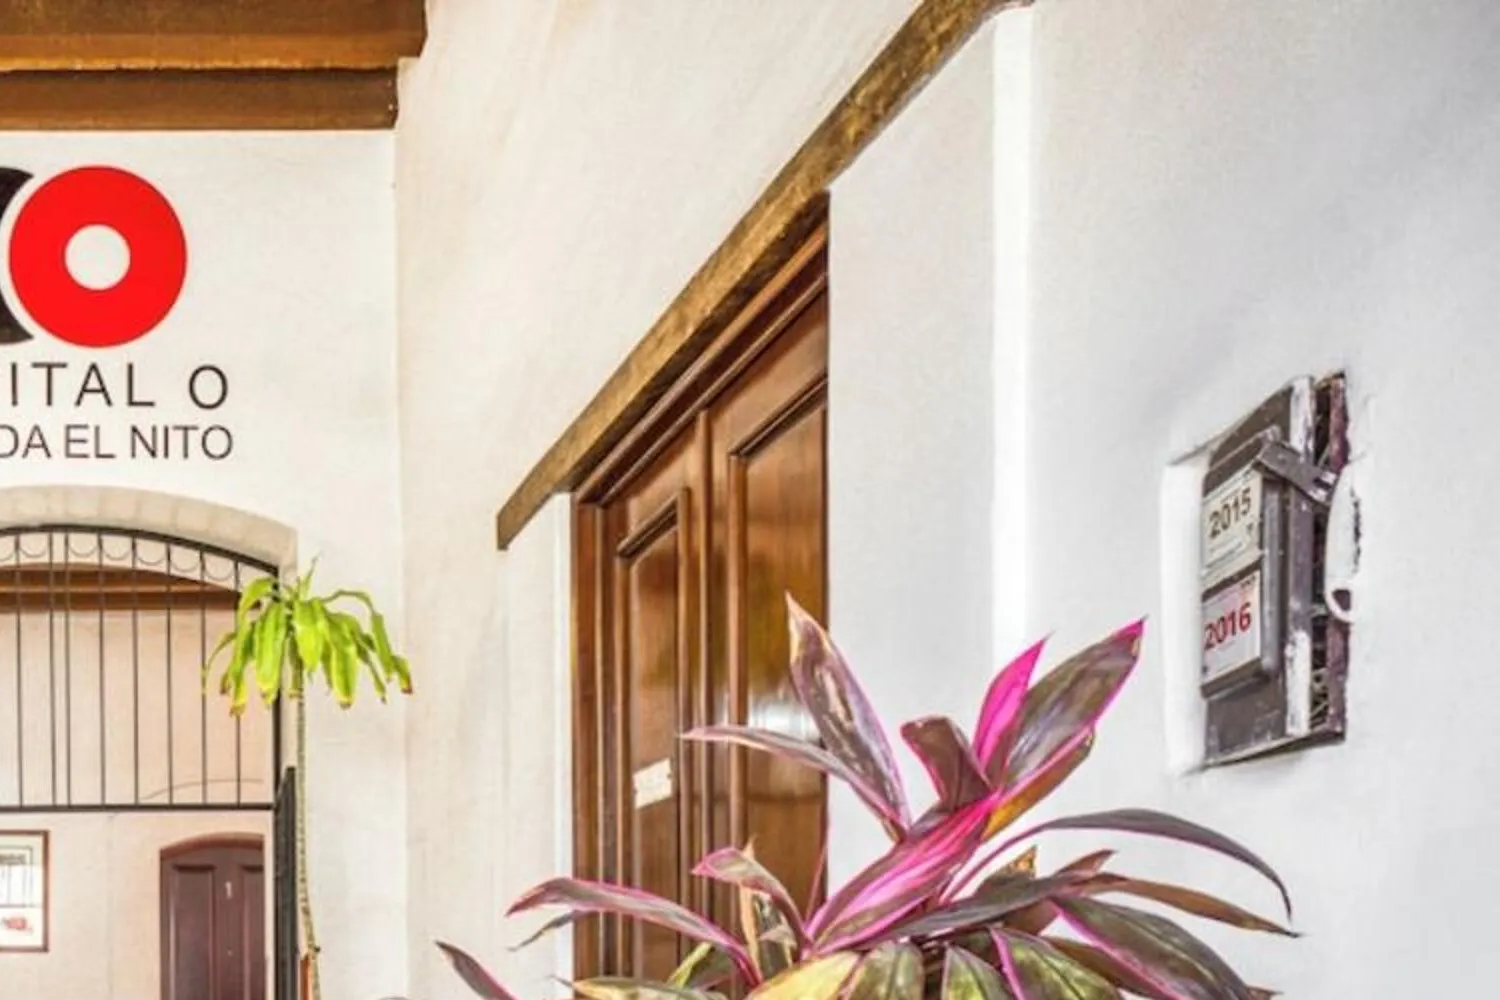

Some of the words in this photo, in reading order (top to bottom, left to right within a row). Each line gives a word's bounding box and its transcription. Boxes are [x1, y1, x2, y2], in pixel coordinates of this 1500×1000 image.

[188, 364, 230, 411] O
[63, 424, 117, 460] EL
[129, 425, 235, 461] NITO
[1208, 486, 1252, 540] 2015
[1203, 601, 1252, 651] 2016
